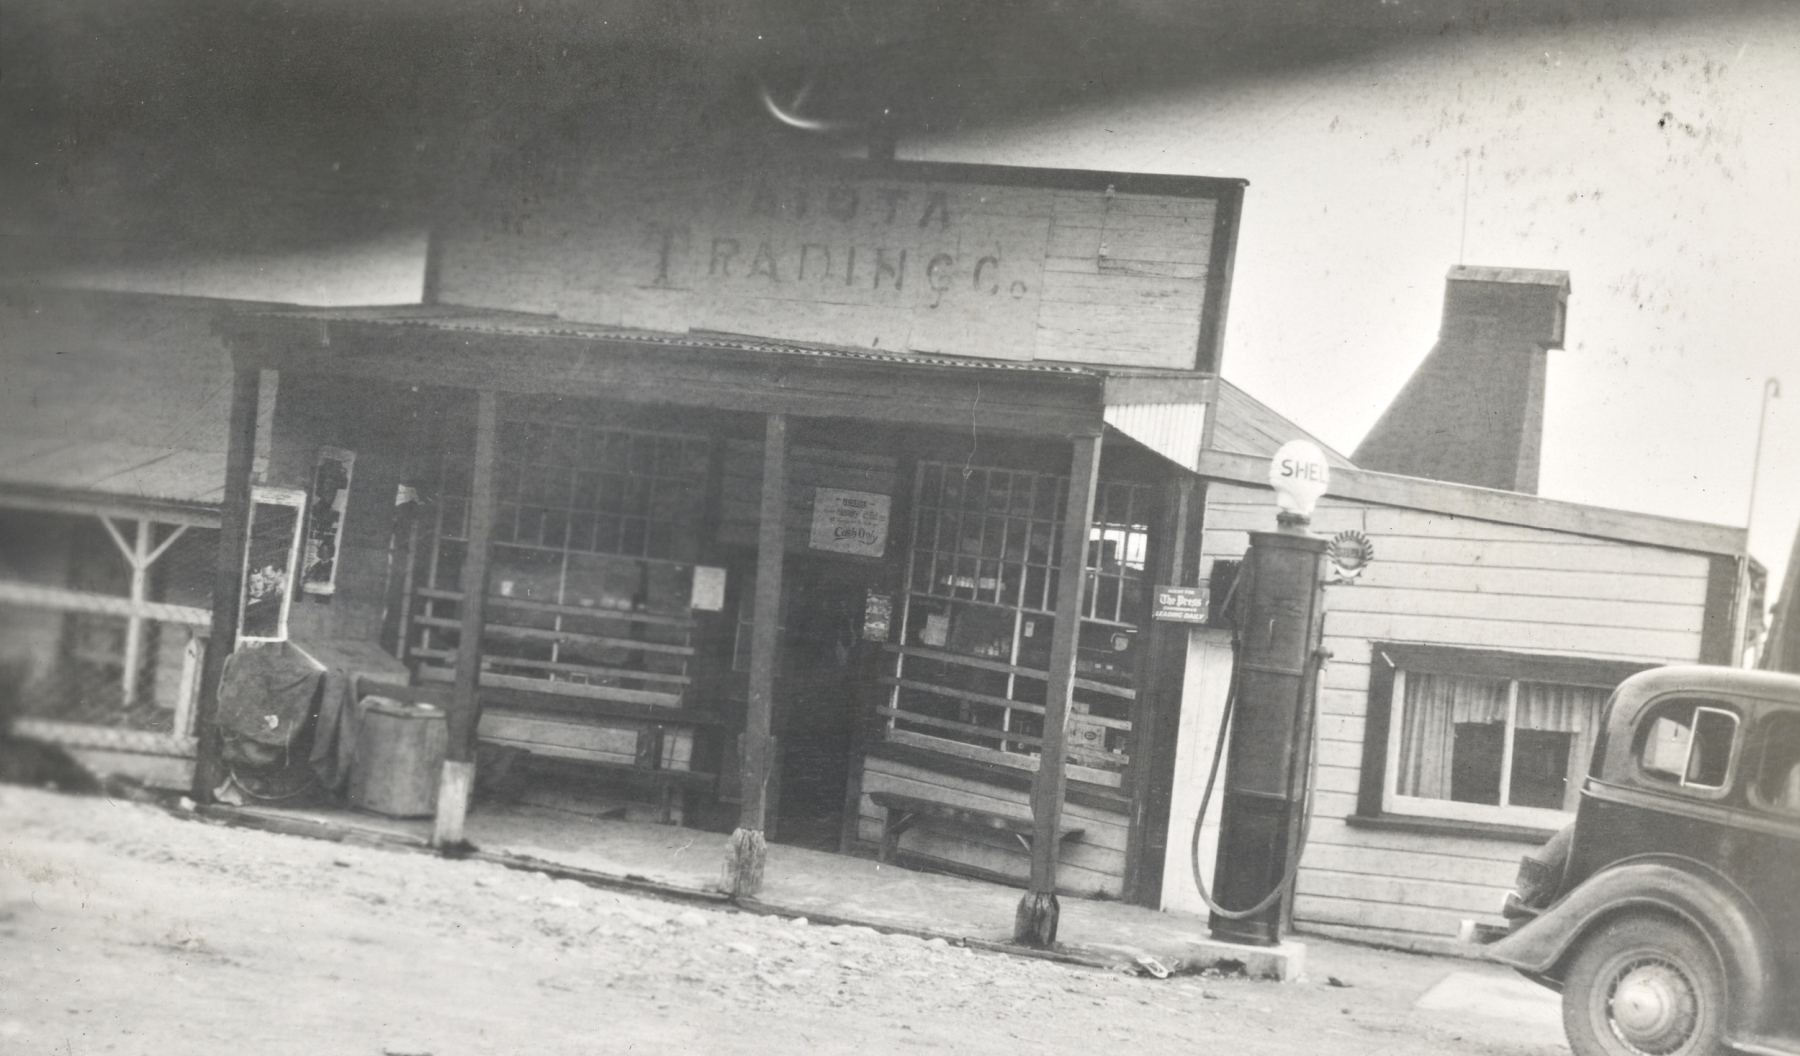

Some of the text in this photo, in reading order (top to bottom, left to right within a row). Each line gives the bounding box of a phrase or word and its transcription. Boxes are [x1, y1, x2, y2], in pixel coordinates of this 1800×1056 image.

[642, 220, 954, 309] TRADING
[1281, 458, 1326, 483] SHEL
[843, 498, 868, 508] NOTICE
[834, 526, 878, 545] Cash Only
[1159, 594, 1202, 607] The Press
